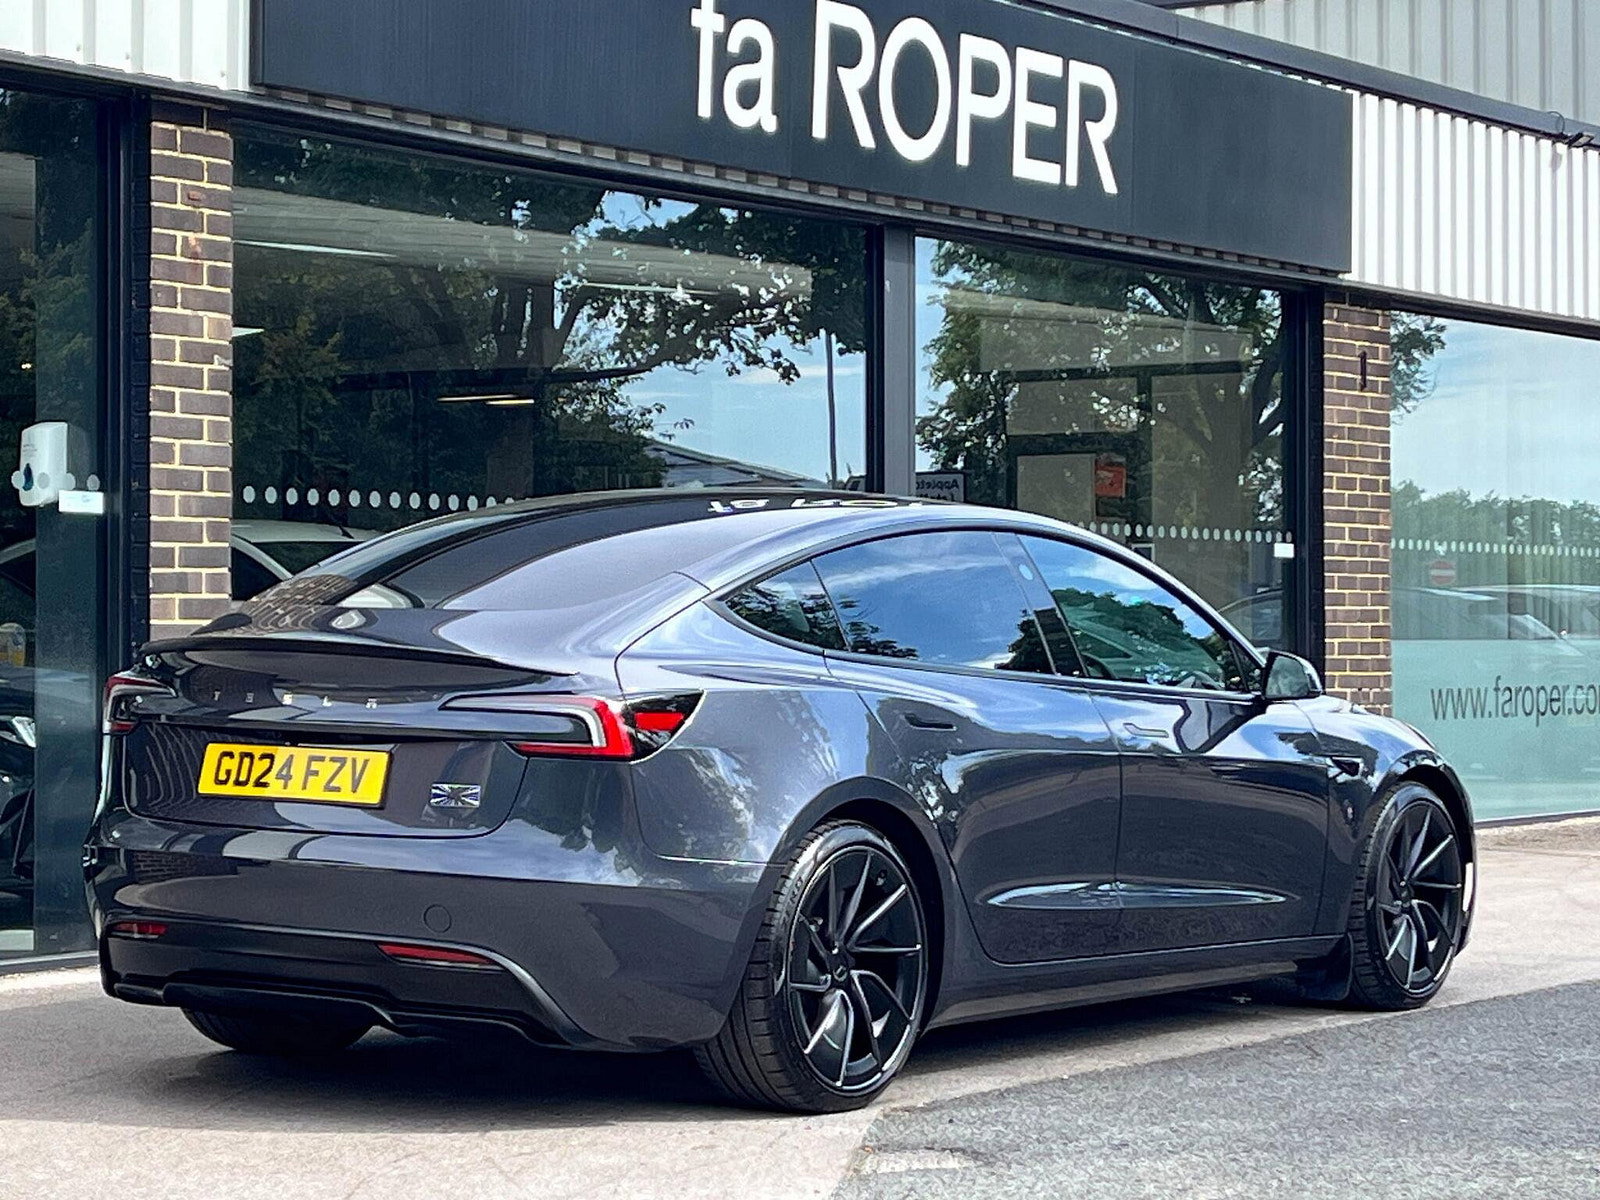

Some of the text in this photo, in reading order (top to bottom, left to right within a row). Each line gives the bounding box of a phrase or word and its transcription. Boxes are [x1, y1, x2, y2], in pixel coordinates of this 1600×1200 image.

[811, 0, 1119, 195] ROPER
[1430, 675, 1600, 727] www.faroper.co
[213, 750, 371, 794] GD24 FZV
